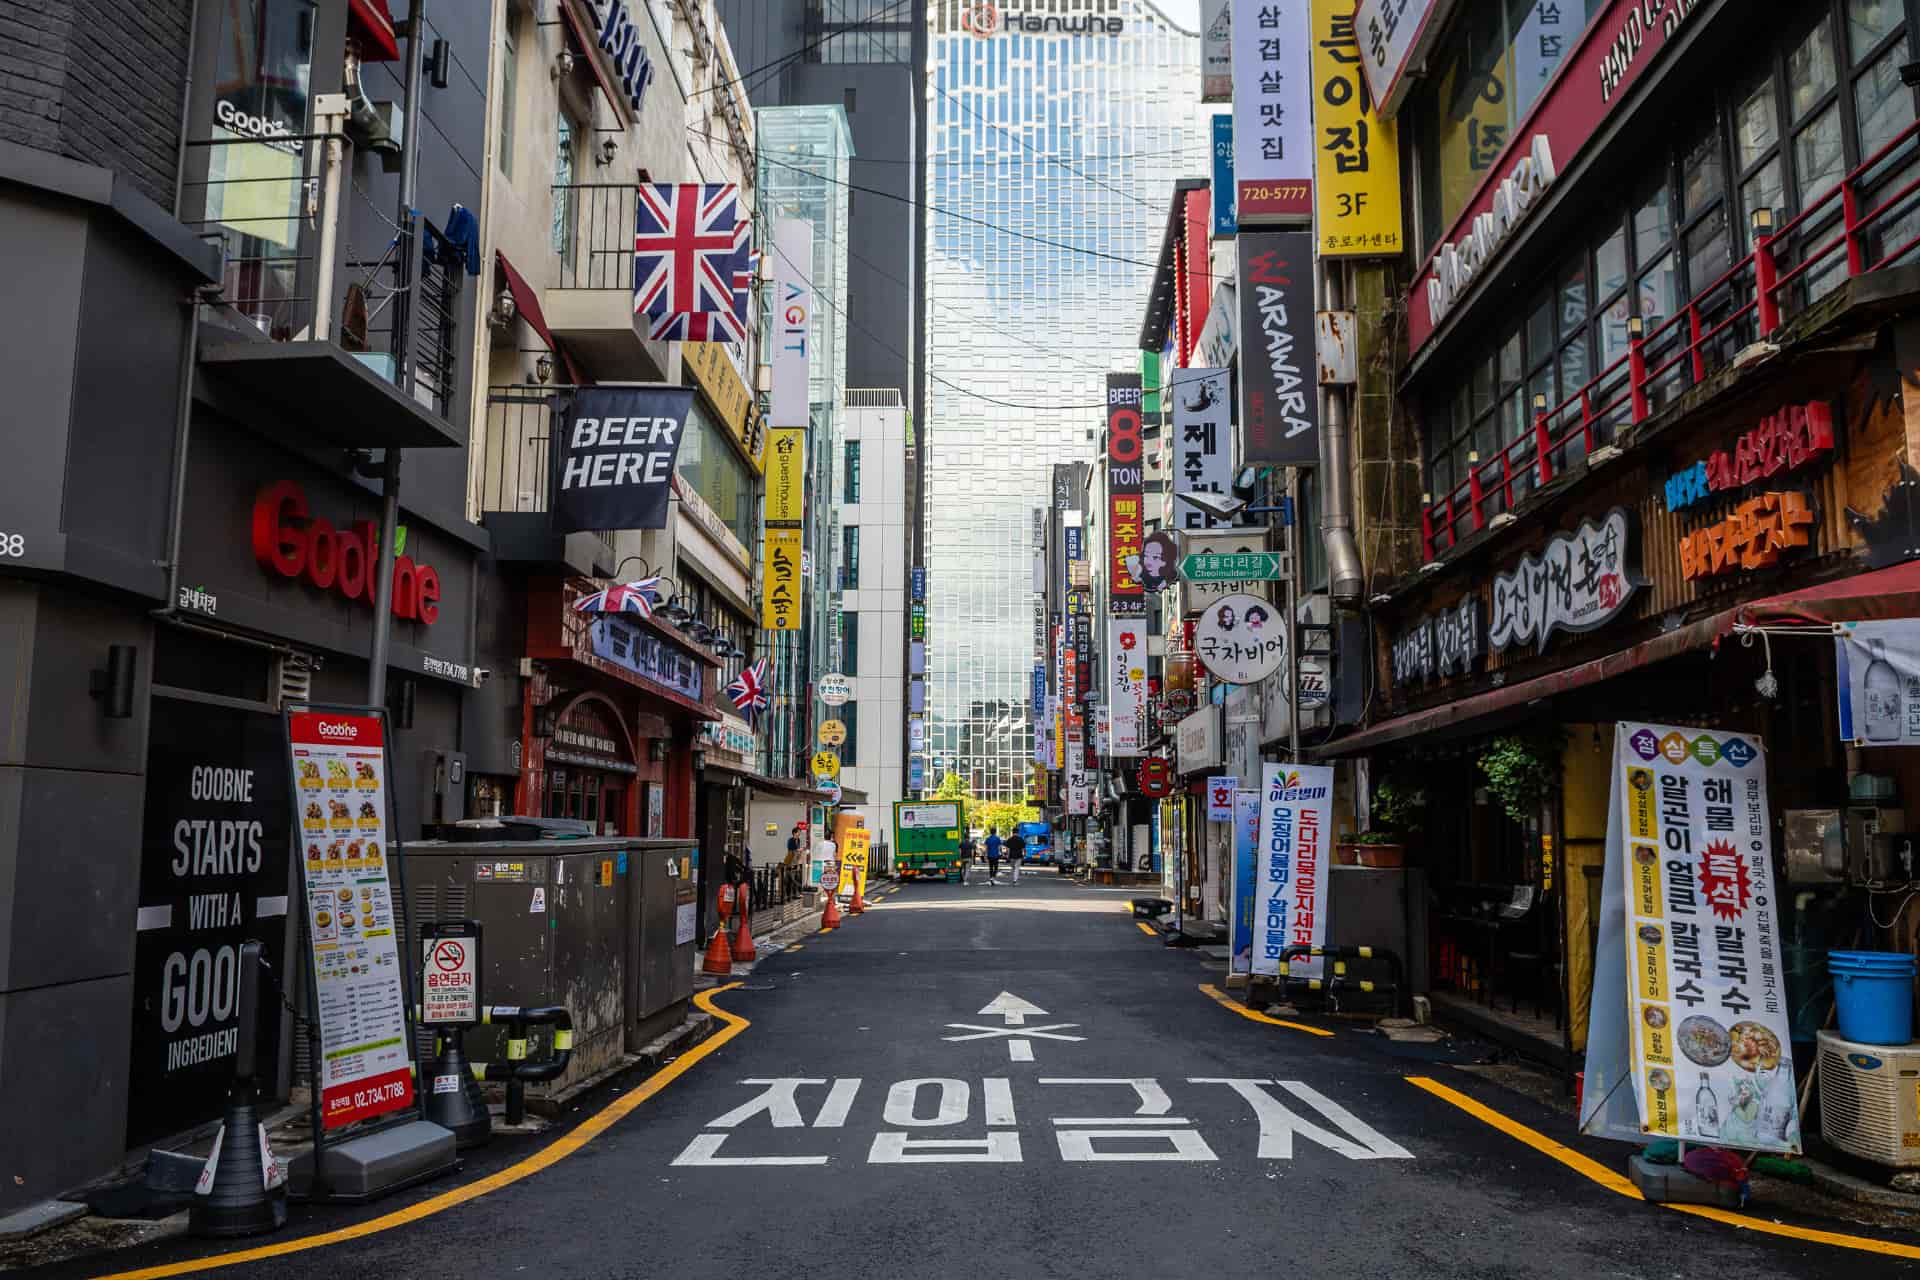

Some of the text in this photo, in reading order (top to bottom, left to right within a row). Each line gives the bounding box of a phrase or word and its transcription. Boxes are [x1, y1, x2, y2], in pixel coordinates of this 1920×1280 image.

[1004, 12, 1123, 33] Hanwha
[1600, 6, 1642, 102] HAND
[1257, 5, 1284, 161] 삼겹살맛집
[1243, 187, 1307, 200] 720-5777
[1337, 193, 1369, 216] 3F
[1247, 250, 1313, 438] WARAWARA
[1110, 388, 1142, 405] BEER
[571, 417, 678, 449] BEER
[1109, 409, 1142, 462] 8
[562, 452, 672, 490] HERE
[780, 454, 792, 518] guesthouse
[1111, 468, 1140, 485] TON
[179, 587, 218, 616] 굽네치킨
[1200, 635, 1284, 664] 국자비어
[318, 721, 358, 737] Goobne
[1636, 734, 1749, 762] 점심특선
[191, 766, 255, 803] GOOBNE
[171, 820, 264, 877] STARTS
[1661, 774, 1704, 1009] 알곤이 얼큰 칼국수
[1703, 777, 1751, 1015] 해물 즉석 칼국수
[189, 894, 242, 931] WITH A
[161, 942, 244, 1034] GOO
[428, 972, 472, 988] 흡연금지
[354, 1084, 406, 1108] 02.734.7788
[668, 1077, 1417, 1167] 진입금지
